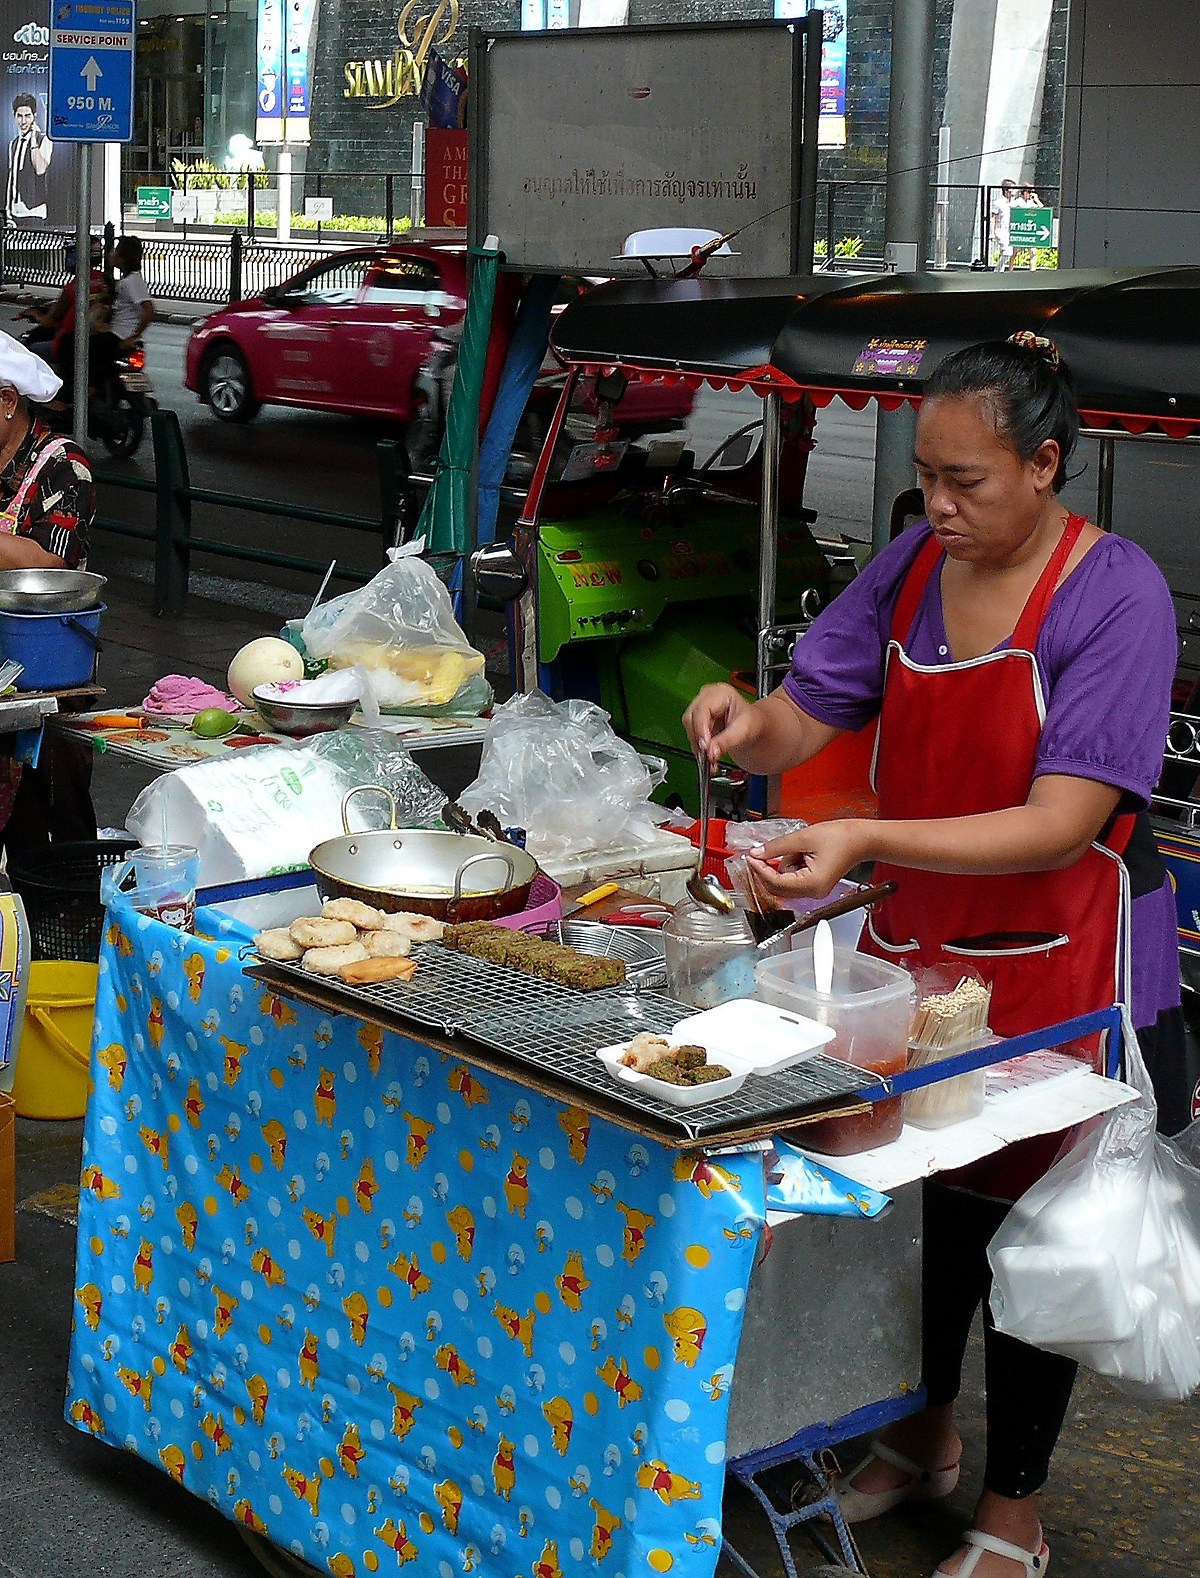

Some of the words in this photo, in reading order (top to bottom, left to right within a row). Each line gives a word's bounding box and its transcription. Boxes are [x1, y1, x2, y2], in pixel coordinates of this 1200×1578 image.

[56, 34, 96, 45] SERVICE
[98, 36, 128, 46] POINT
[440, 66, 461, 96] VISA
[67, 96, 95, 110] 950
[98, 97, 115, 111] M.
[570, 566, 623, 588] NEW
